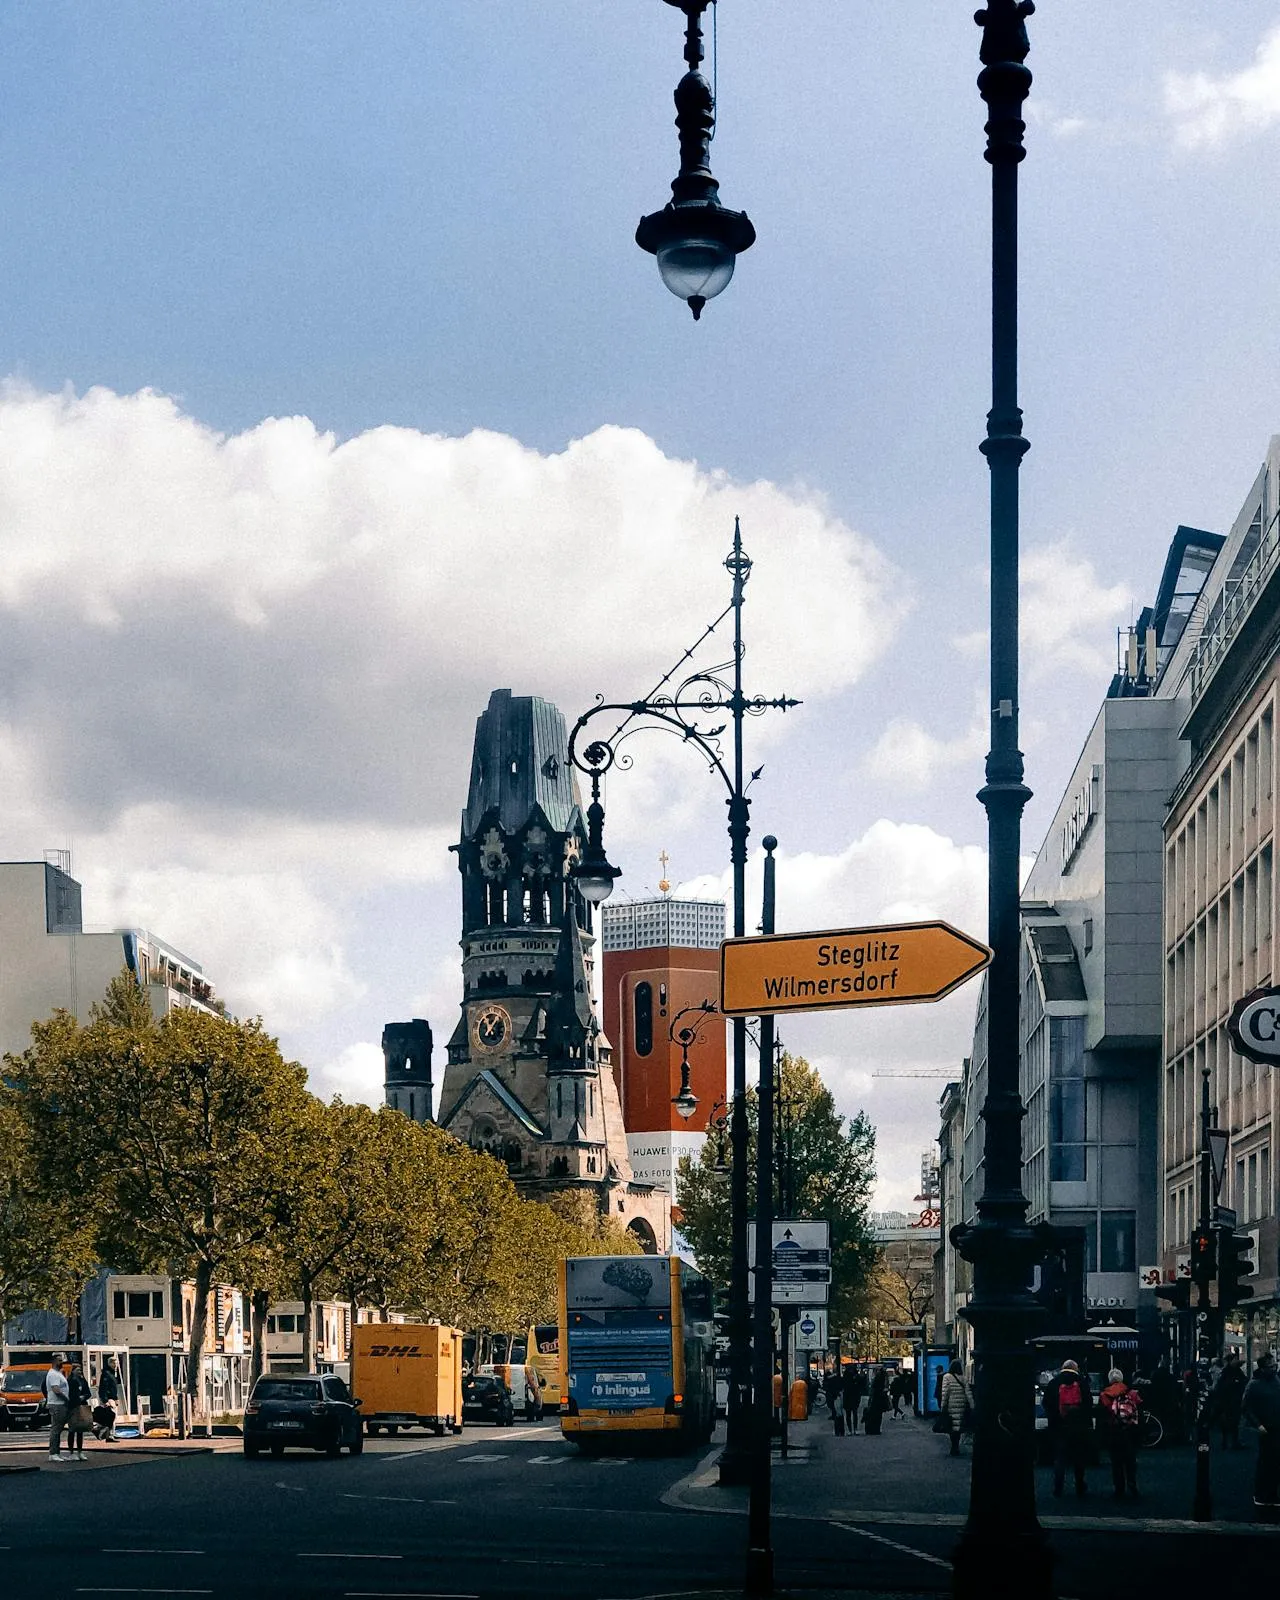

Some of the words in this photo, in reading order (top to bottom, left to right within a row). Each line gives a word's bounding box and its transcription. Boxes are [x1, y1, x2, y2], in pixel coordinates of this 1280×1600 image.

[817, 941, 900, 969] Steglitz
[764, 968, 899, 999] Wilmersdorf
[633, 1146, 670, 1157] HUAWEI
[672, 1146, 687, 1156] P30
[633, 1170, 649, 1178] DAS
[651, 1169, 671, 1178] FOTO
[369, 1345, 422, 1358] DHL
[605, 1383, 651, 1397] inlingua
